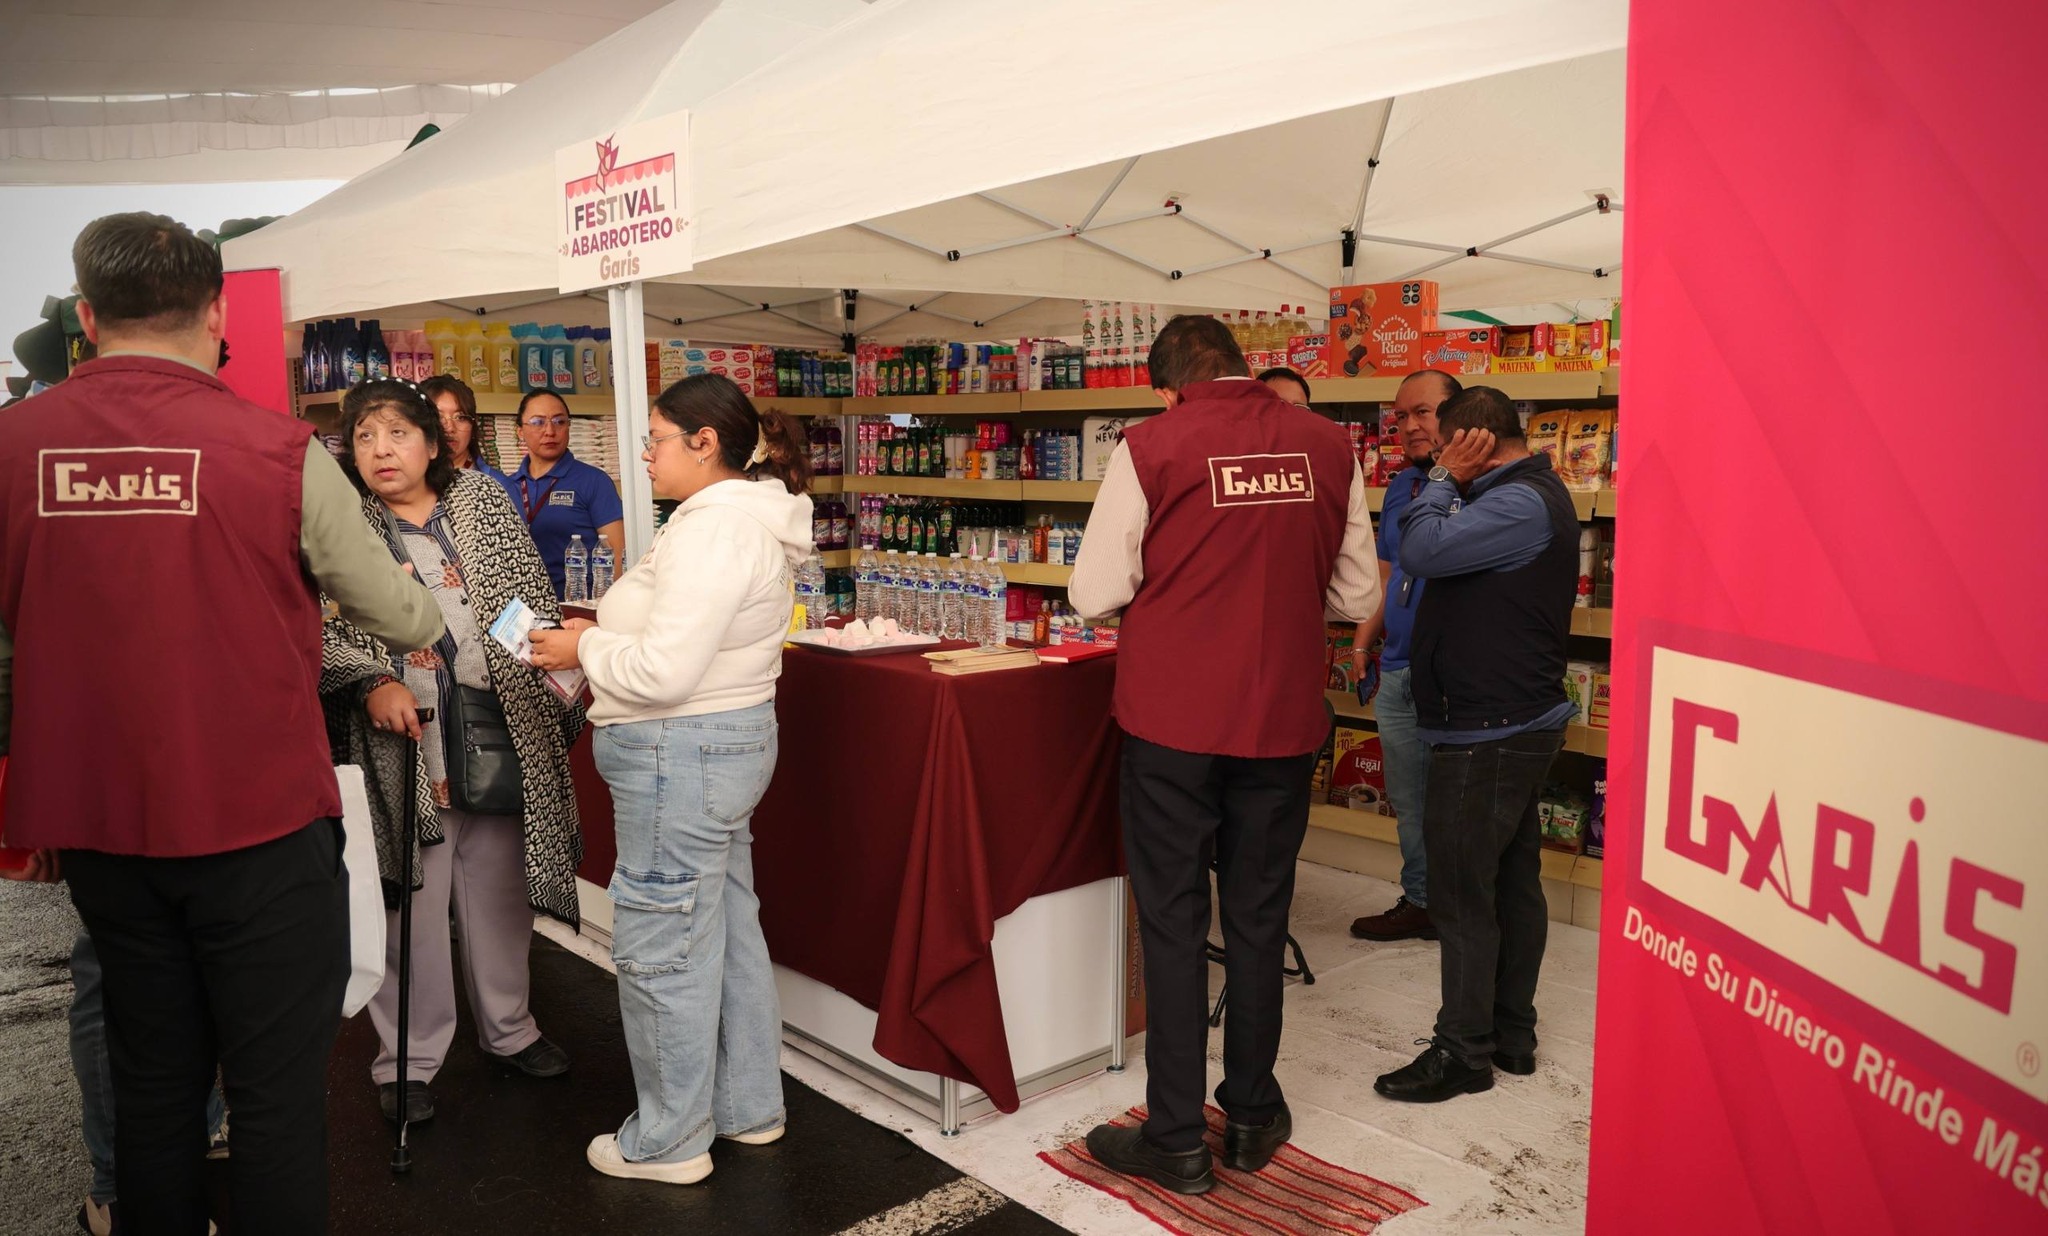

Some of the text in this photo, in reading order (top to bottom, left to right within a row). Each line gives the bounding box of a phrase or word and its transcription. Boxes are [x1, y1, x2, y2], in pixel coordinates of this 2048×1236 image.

[574, 185, 665, 231] FESTIVAL
[571, 217, 673, 258] ABARROTERO
[600, 250, 640, 280] Garis
[1372, 328, 1418, 342] Surtido
[1381, 342, 1408, 355] Rico
[1382, 359, 1408, 369] Original
[1498, 362, 1536, 373] MAIZENA
[1554, 360, 1594, 372] MAIZENA
[529, 373, 547, 383] FOCA
[554, 374, 571, 384] FOCA
[1095, 430, 1118, 443] NEVA
[1354, 757, 1381, 773] Legal
[1623, 906, 1698, 977] Donde
[1704, 953, 1737, 1002] Su
[1744, 976, 1847, 1069] Dinero
[1853, 1042, 1965, 1145] Rinde
